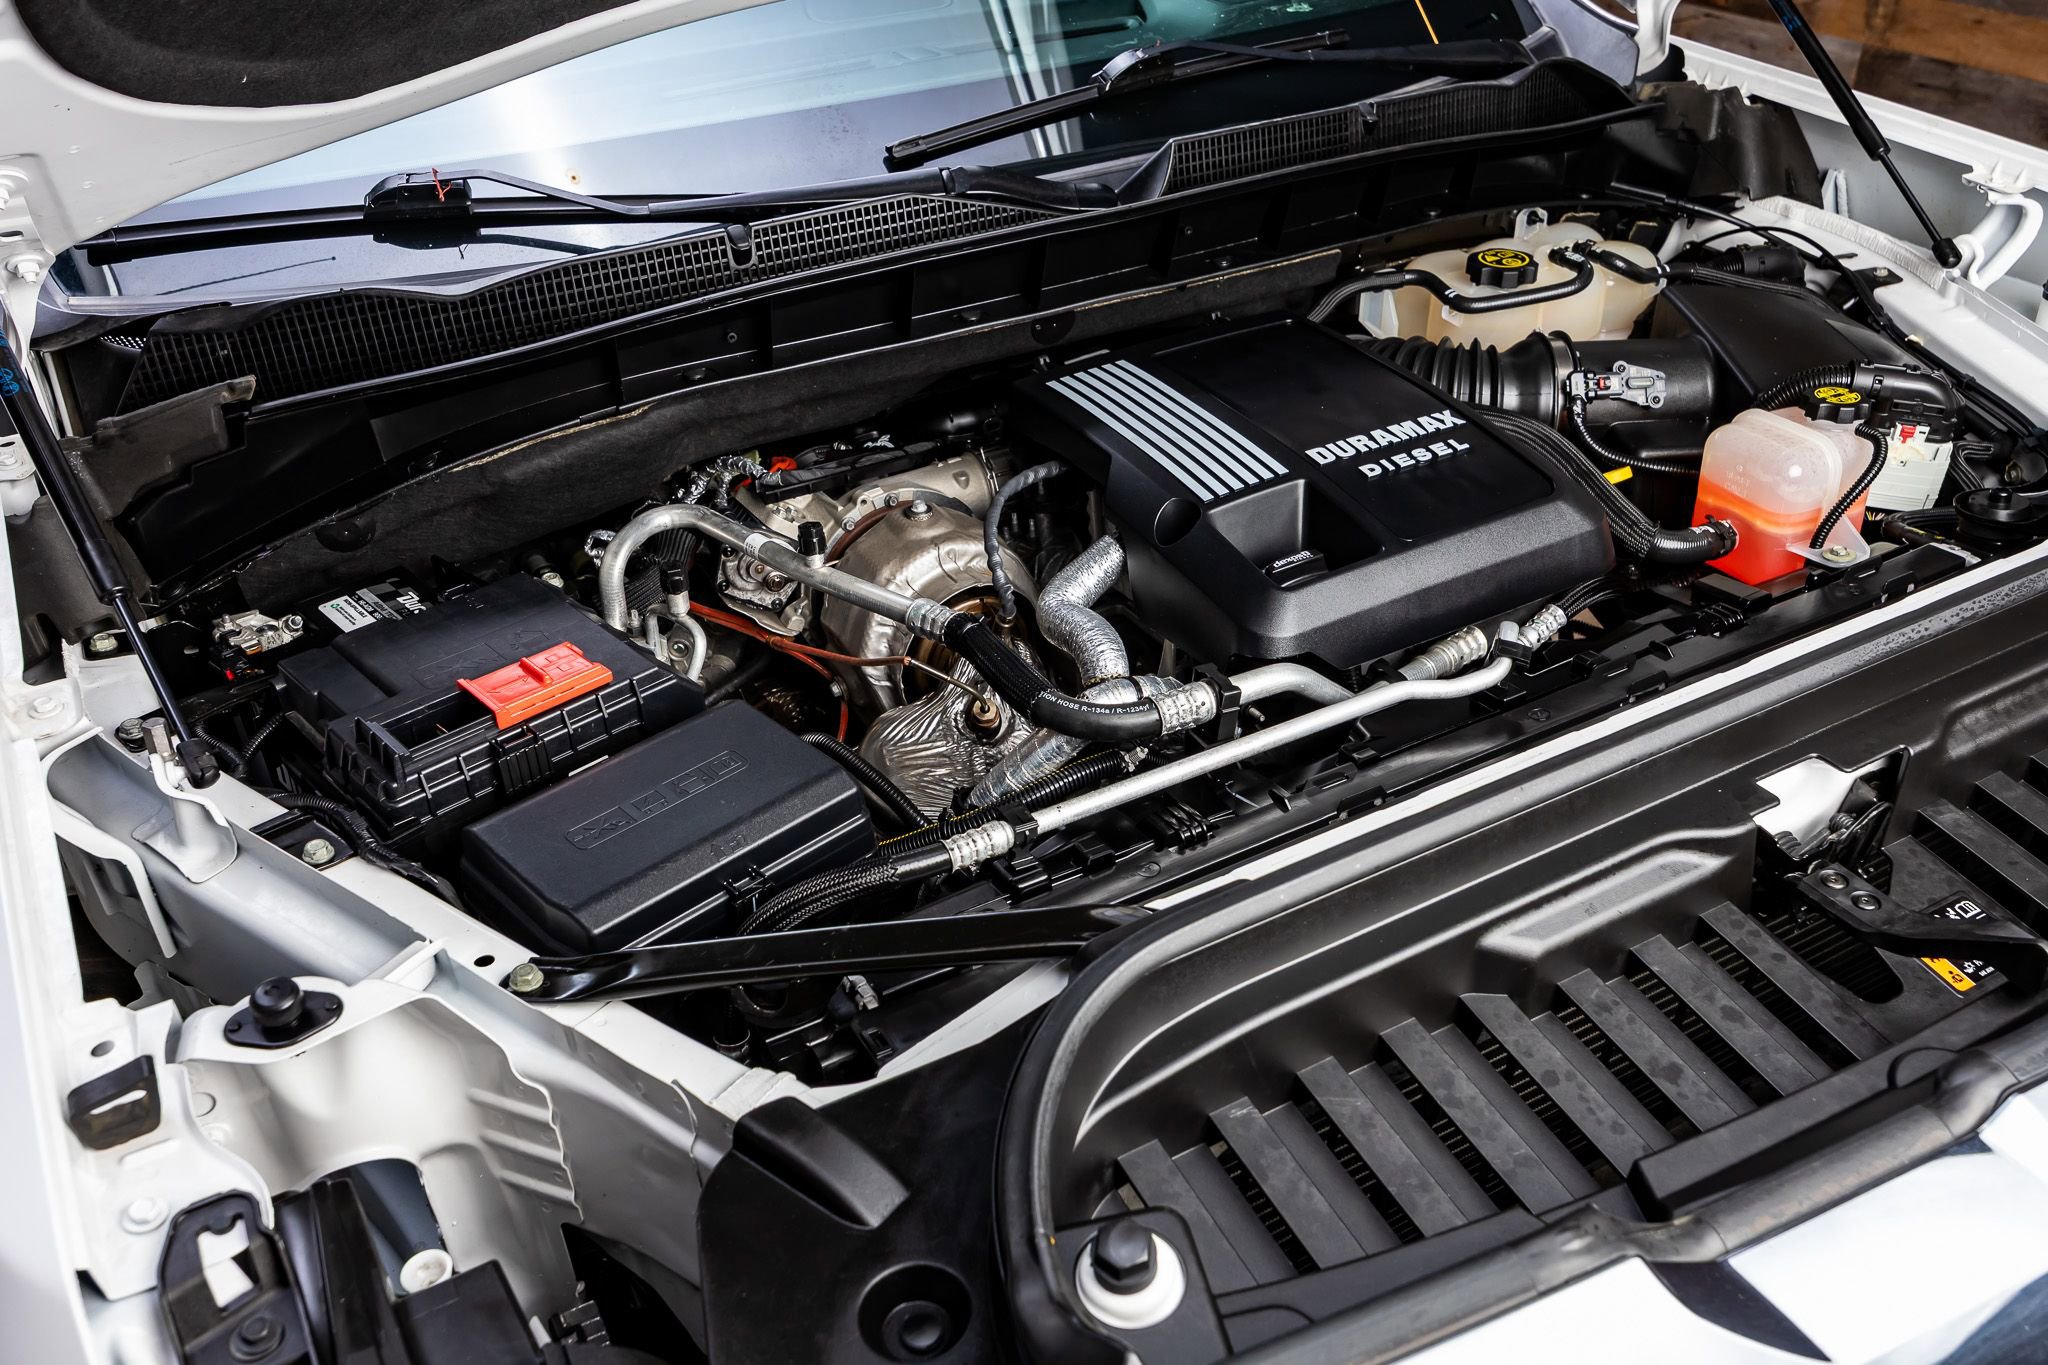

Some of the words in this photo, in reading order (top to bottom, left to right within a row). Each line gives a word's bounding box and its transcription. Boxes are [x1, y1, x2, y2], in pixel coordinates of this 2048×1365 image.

[1305, 409, 1466, 465] DURAMAX
[1358, 439, 1470, 478] DIESEL
[1057, 698, 1080, 710] HOSE
[1081, 705, 1110, 714] R-134a
